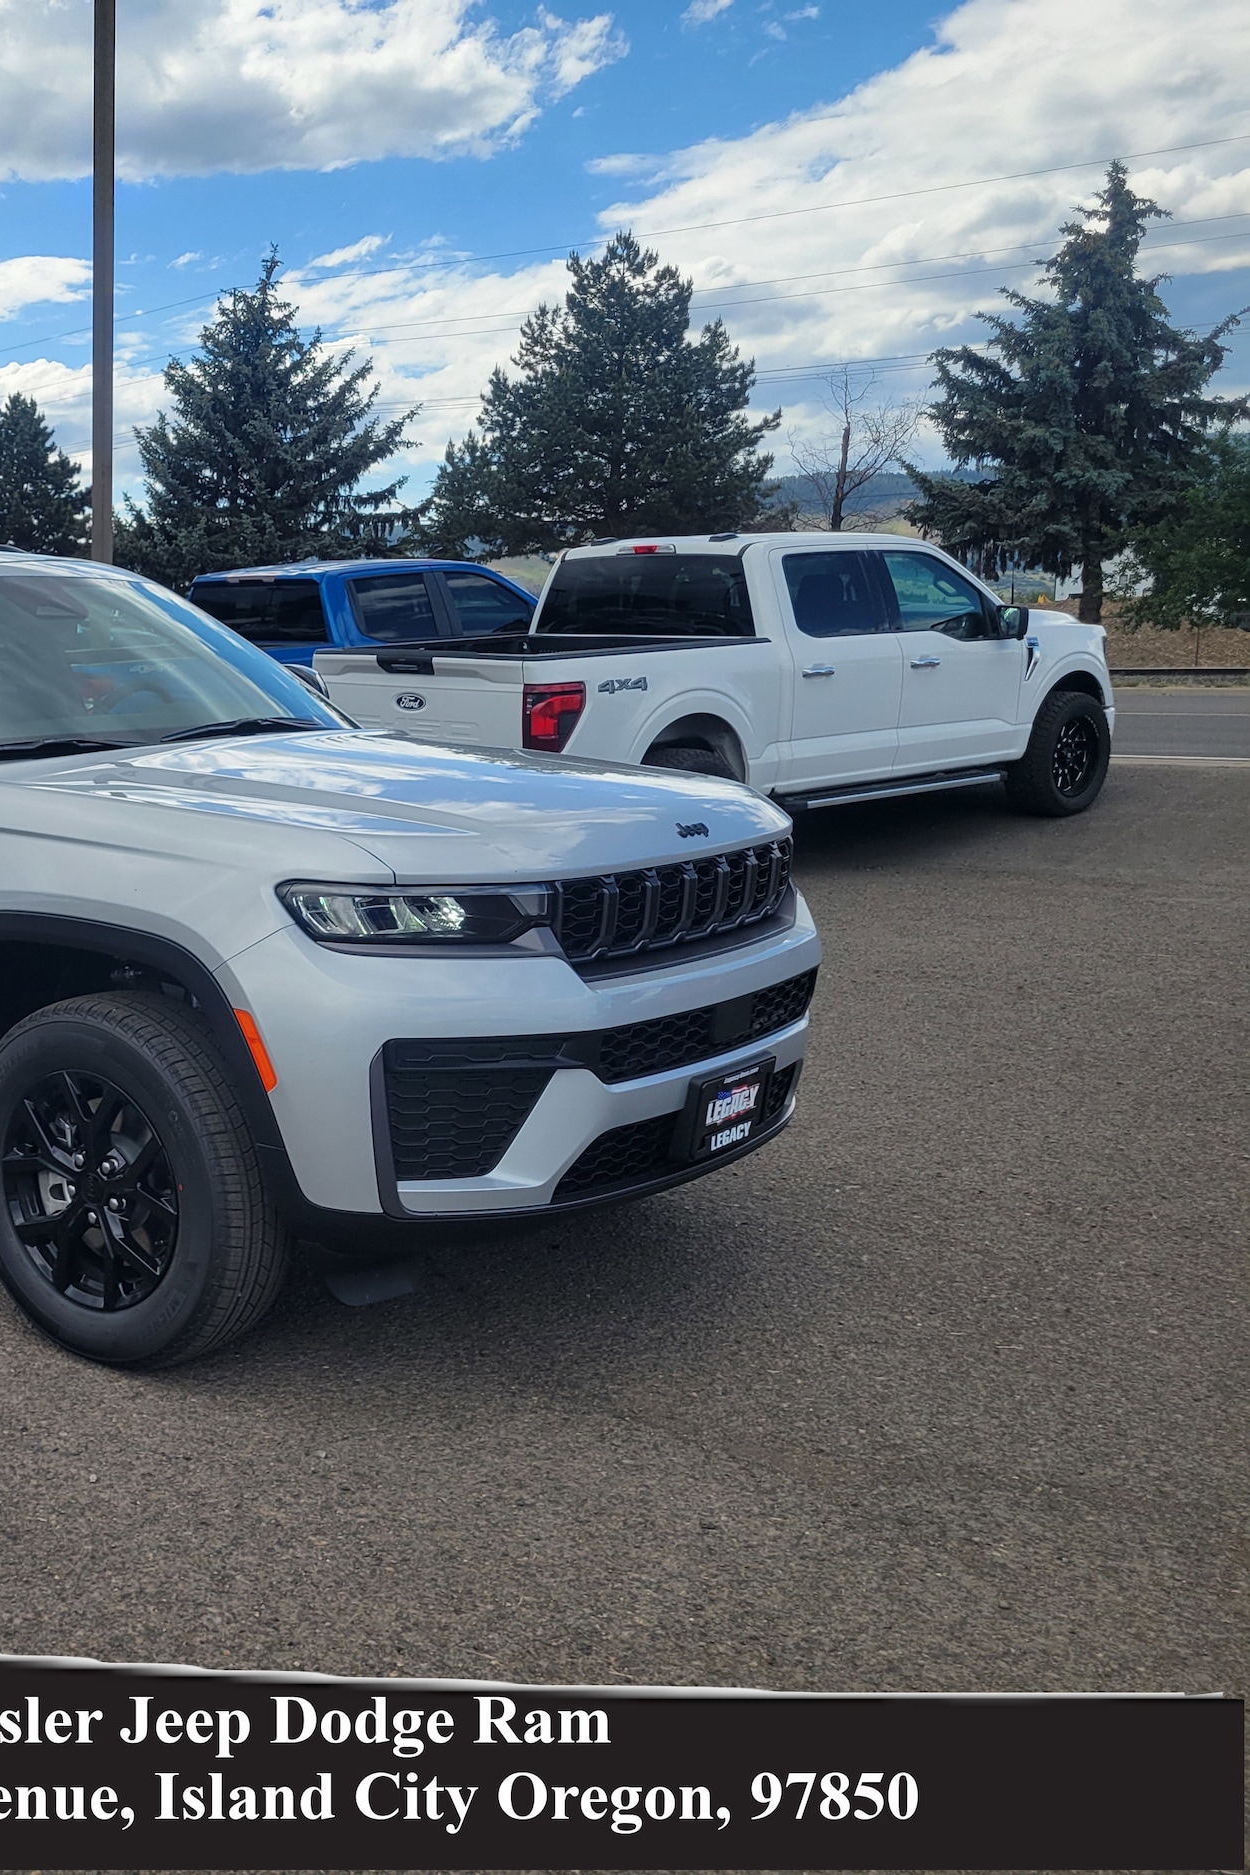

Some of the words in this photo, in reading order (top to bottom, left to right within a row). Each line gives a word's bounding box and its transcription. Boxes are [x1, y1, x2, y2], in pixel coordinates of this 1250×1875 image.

[399, 695, 421, 708] Ford
[675, 822, 710, 838] Jeep
[705, 1083, 760, 1127] LEGACY
[710, 1121, 752, 1151] LEGACY
